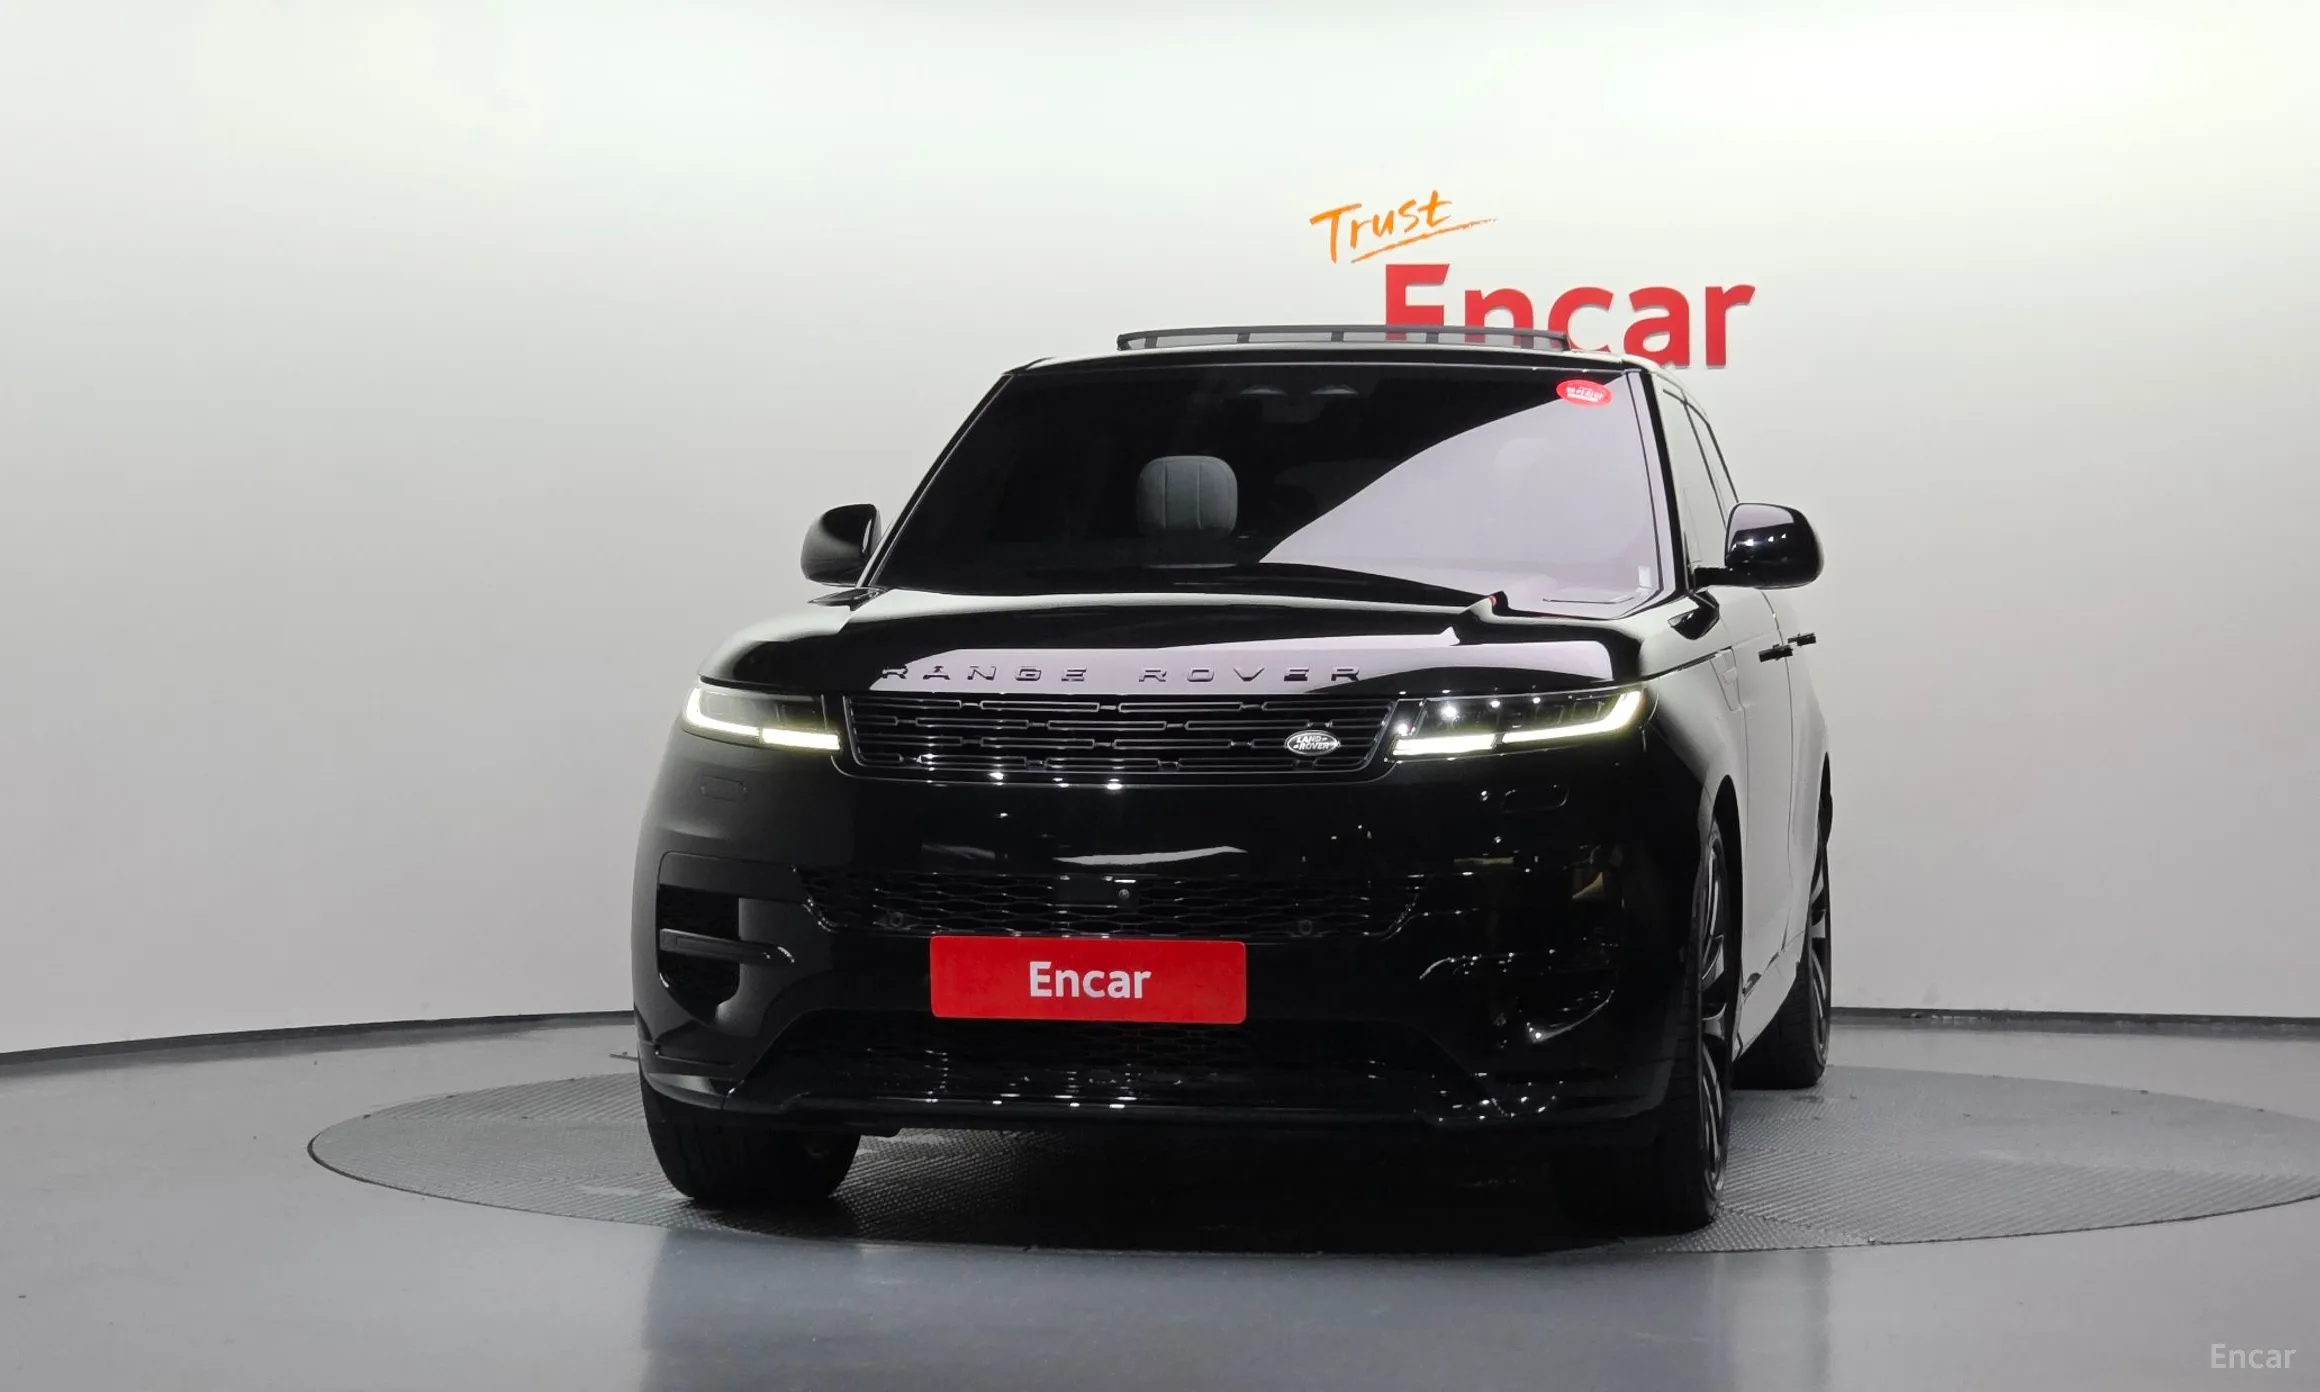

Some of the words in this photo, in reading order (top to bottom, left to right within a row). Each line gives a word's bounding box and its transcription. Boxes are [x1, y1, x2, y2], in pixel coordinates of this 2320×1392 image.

[1310, 190, 1452, 263] Trust
[1385, 263, 1756, 367] Encar
[881, 665, 1088, 682] RANGE
[1138, 665, 1361, 683] ROVER
[1296, 735, 1322, 743] LAND
[1299, 742, 1329, 750] ROVER
[1029, 960, 1152, 999] Encar
